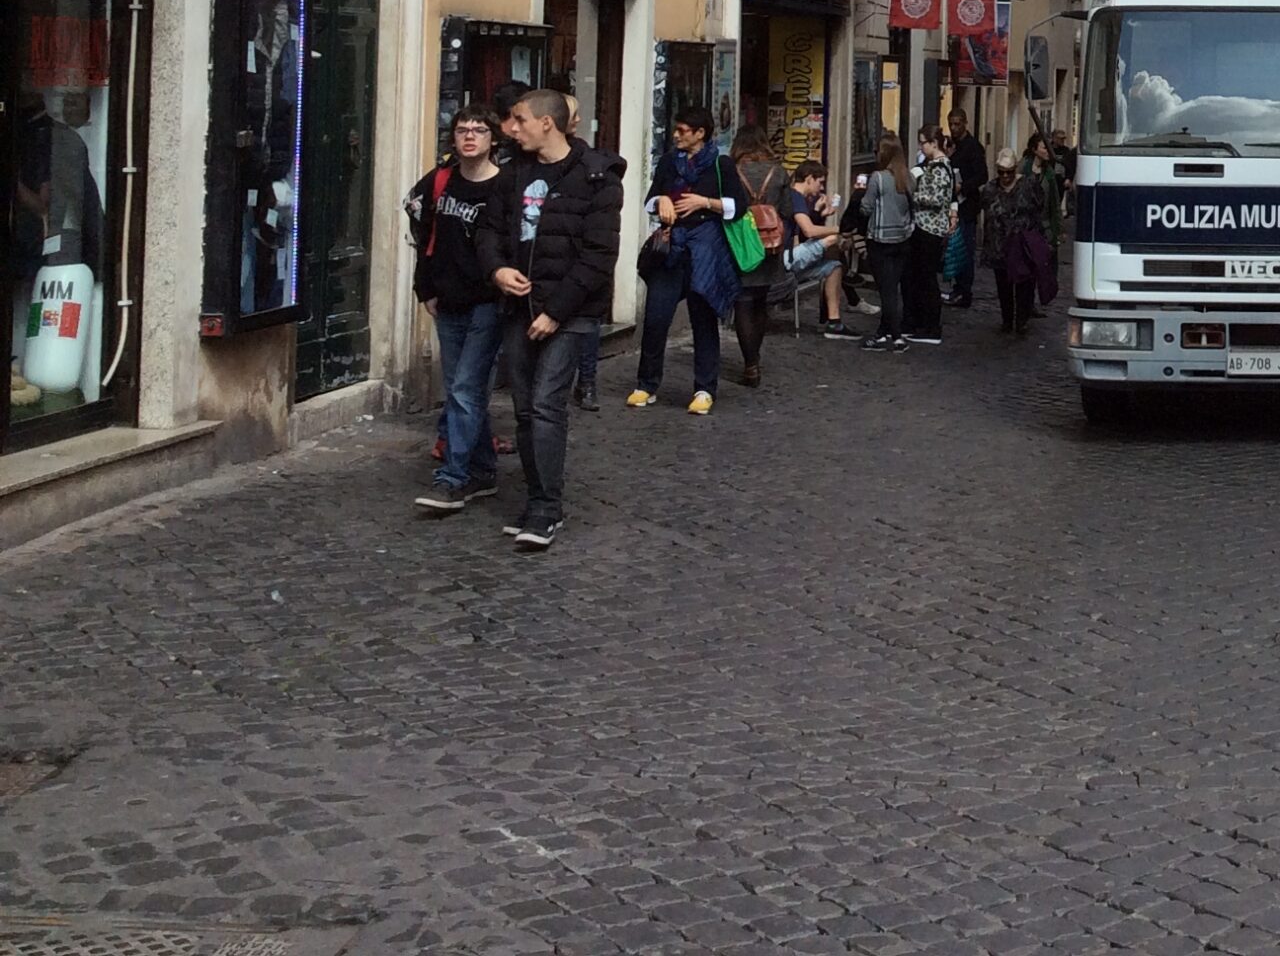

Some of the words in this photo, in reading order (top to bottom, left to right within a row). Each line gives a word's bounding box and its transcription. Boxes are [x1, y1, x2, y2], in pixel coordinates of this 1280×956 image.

[784, 32, 812, 170] CREPES
[1146, 204, 1236, 229] POLIZIA
[41, 280, 74, 300] MM
[1249, 357, 1271, 370] 708
